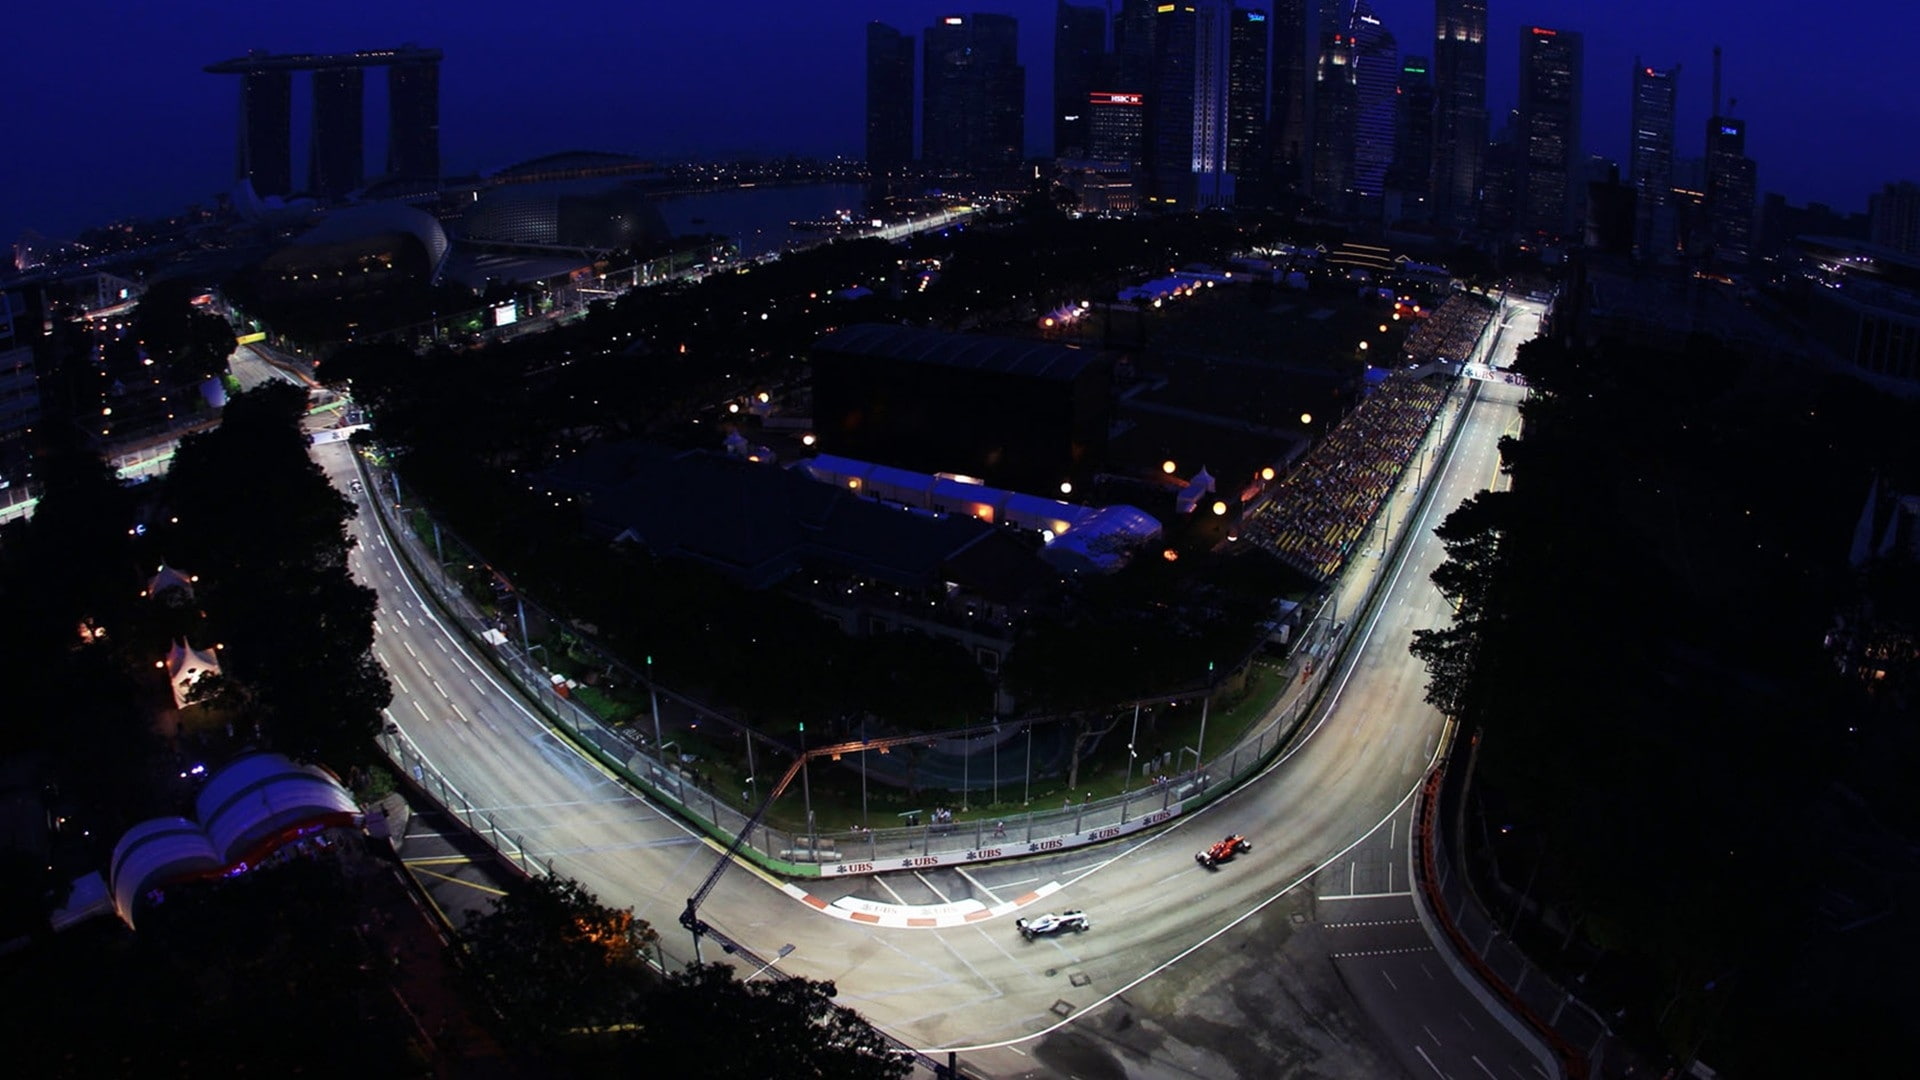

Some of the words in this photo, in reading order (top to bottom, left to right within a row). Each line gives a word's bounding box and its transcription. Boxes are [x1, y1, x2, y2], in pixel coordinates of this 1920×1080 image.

[1152, 811, 1171, 823] UBS
[1099, 827, 1120, 839] UBS
[1040, 839, 1063, 850] UBS
[978, 848, 1001, 858] UBS
[914, 856, 938, 866] UBS
[848, 863, 873, 873] UBS
